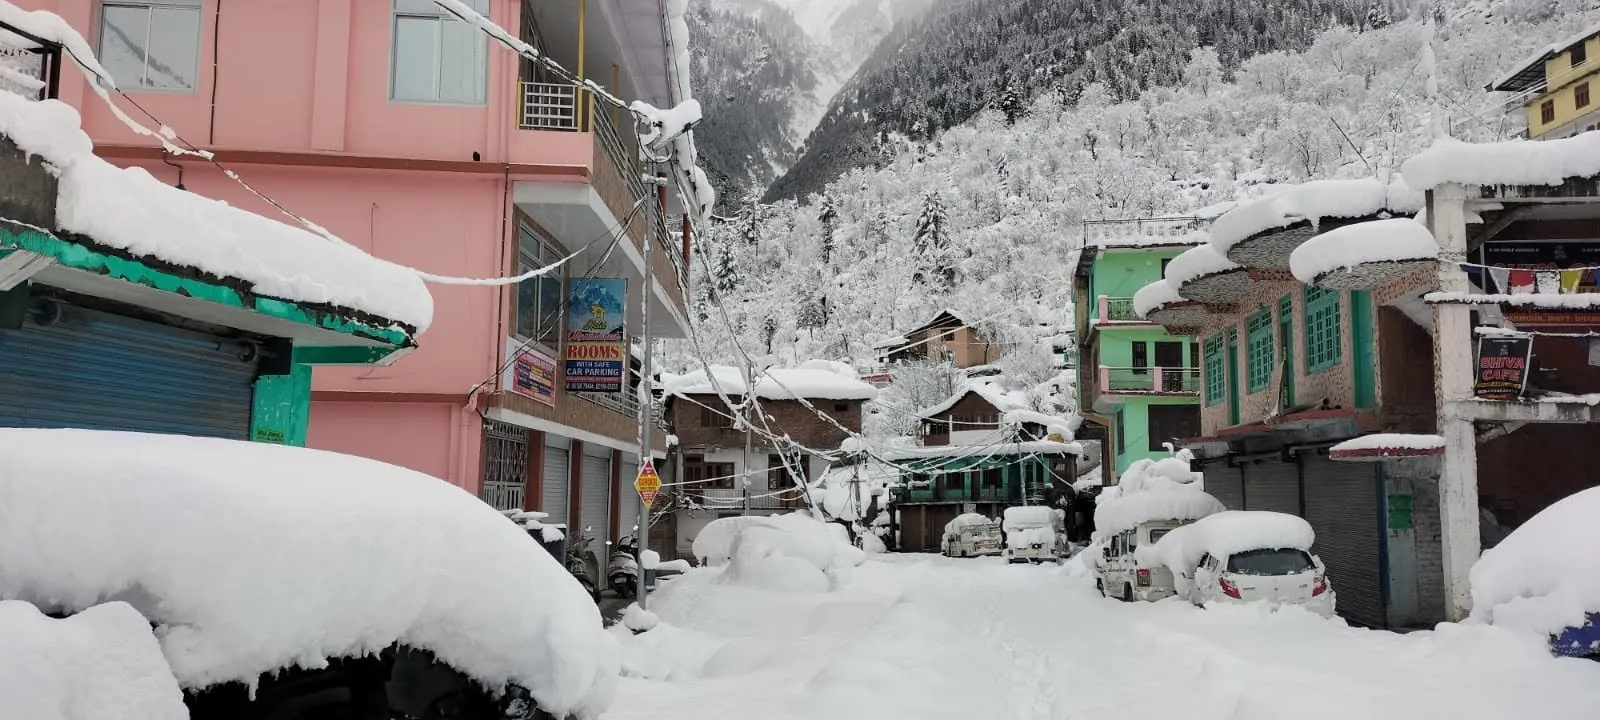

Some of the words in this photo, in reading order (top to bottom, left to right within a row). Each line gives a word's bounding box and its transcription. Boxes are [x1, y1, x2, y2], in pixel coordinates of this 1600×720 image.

[567, 344, 620, 359] ROOMS
[1480, 356, 1525, 369] SHIVA
[566, 368, 583, 376] CAR
[585, 368, 619, 376] PARKING
[1482, 369, 1521, 382] CAFE
